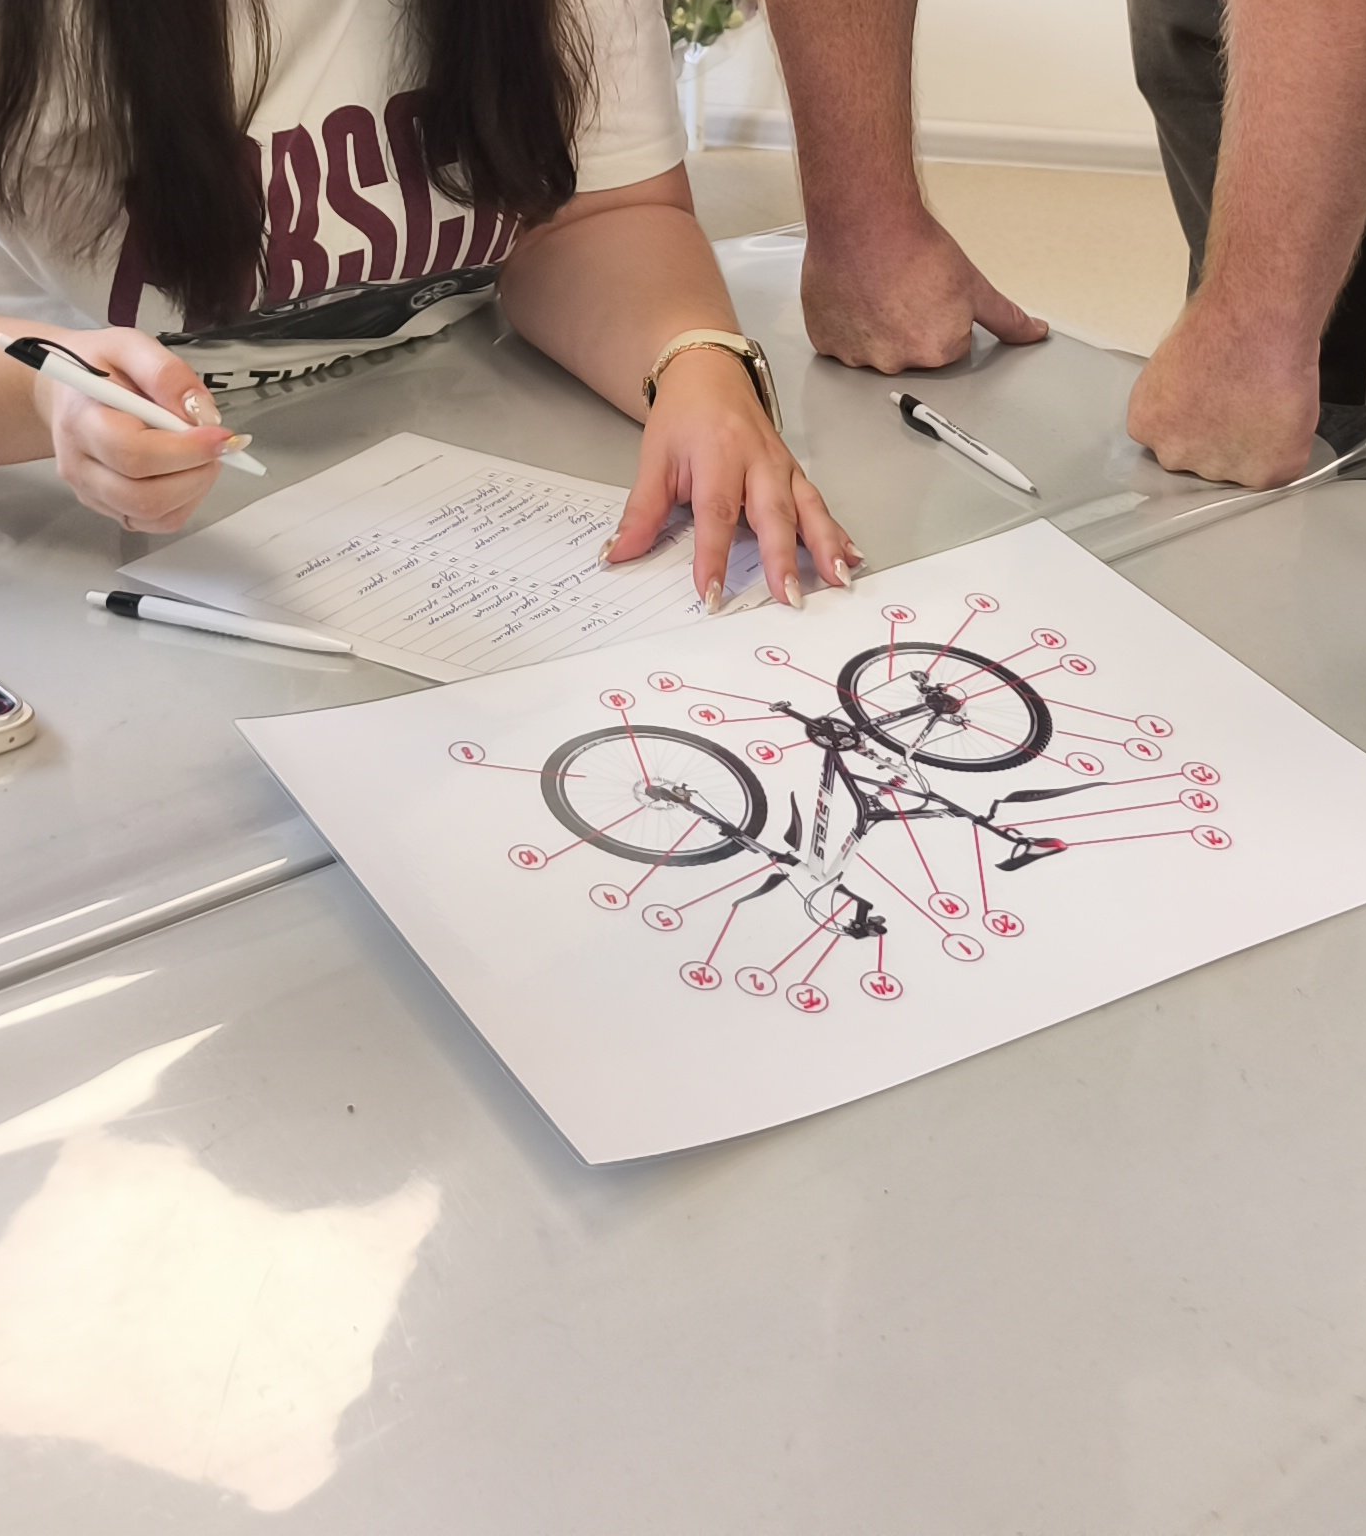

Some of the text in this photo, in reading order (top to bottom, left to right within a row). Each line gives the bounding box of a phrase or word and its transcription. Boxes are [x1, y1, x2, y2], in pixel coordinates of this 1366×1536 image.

[977, 599, 990, 609] 11
[1041, 633, 1058, 646] 12
[660, 678, 674, 689] 17
[611, 694, 627, 707] 18
[1150, 722, 1165, 734] 7
[1137, 744, 1152, 756] 6
[1079, 760, 1093, 771] 9
[1191, 765, 1212, 782] 23
[1190, 792, 1211, 809] 22
[813, 804, 831, 861] STELS
[1203, 831, 1222, 845] 21
[520, 851, 538, 866] 10
[603, 892, 618, 904] 4
[656, 911, 673, 927] 5
[992, 914, 1016, 934] 20
[958, 942, 971, 956] 1
[690, 968, 713, 985] 26
[750, 974, 764, 990] 2
[871, 975, 893, 994] 24
[797, 989, 820, 1009] 25
